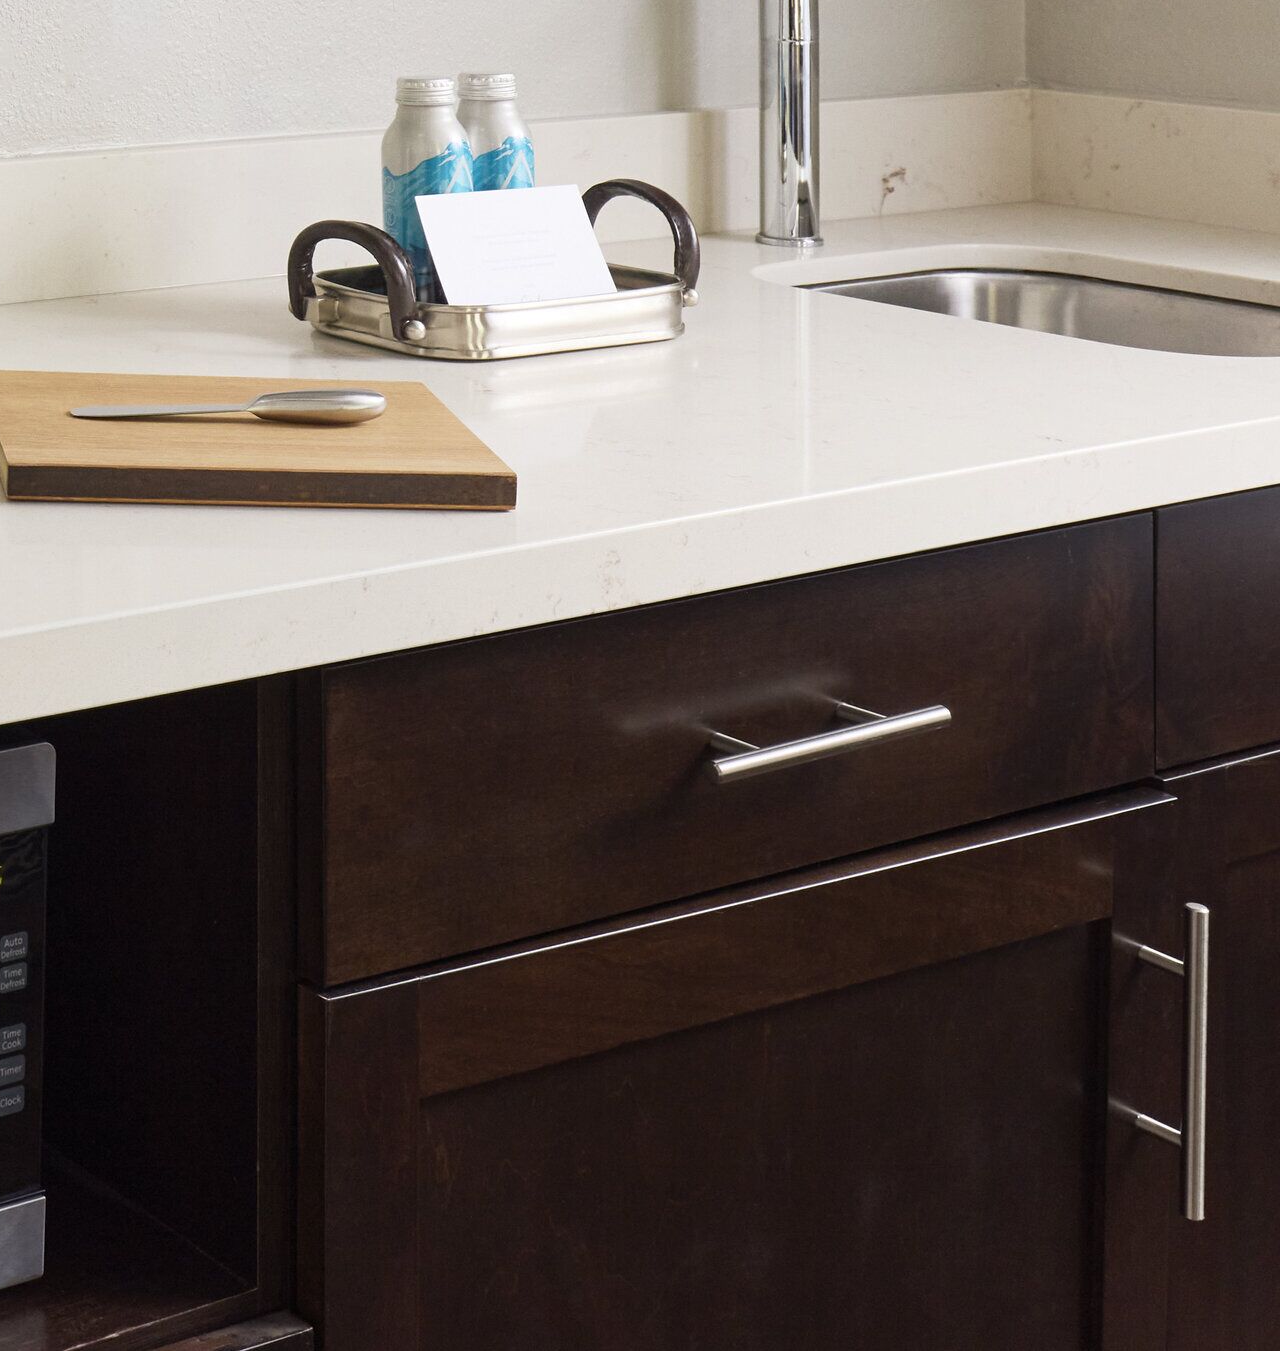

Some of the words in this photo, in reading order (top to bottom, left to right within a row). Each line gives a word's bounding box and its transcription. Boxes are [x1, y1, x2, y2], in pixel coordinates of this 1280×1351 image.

[4, 937, 23, 948] Auto
[0, 947, 26, 960] Defrost
[4, 967, 23, 979] Time
[0, 978, 25, 991] Defrost
[2, 1029, 22, 1040] Time
[1, 1038, 22, 1050] Cook
[0, 1064, 22, 1077] Timer
[0, 1096, 22, 1109] Clock
